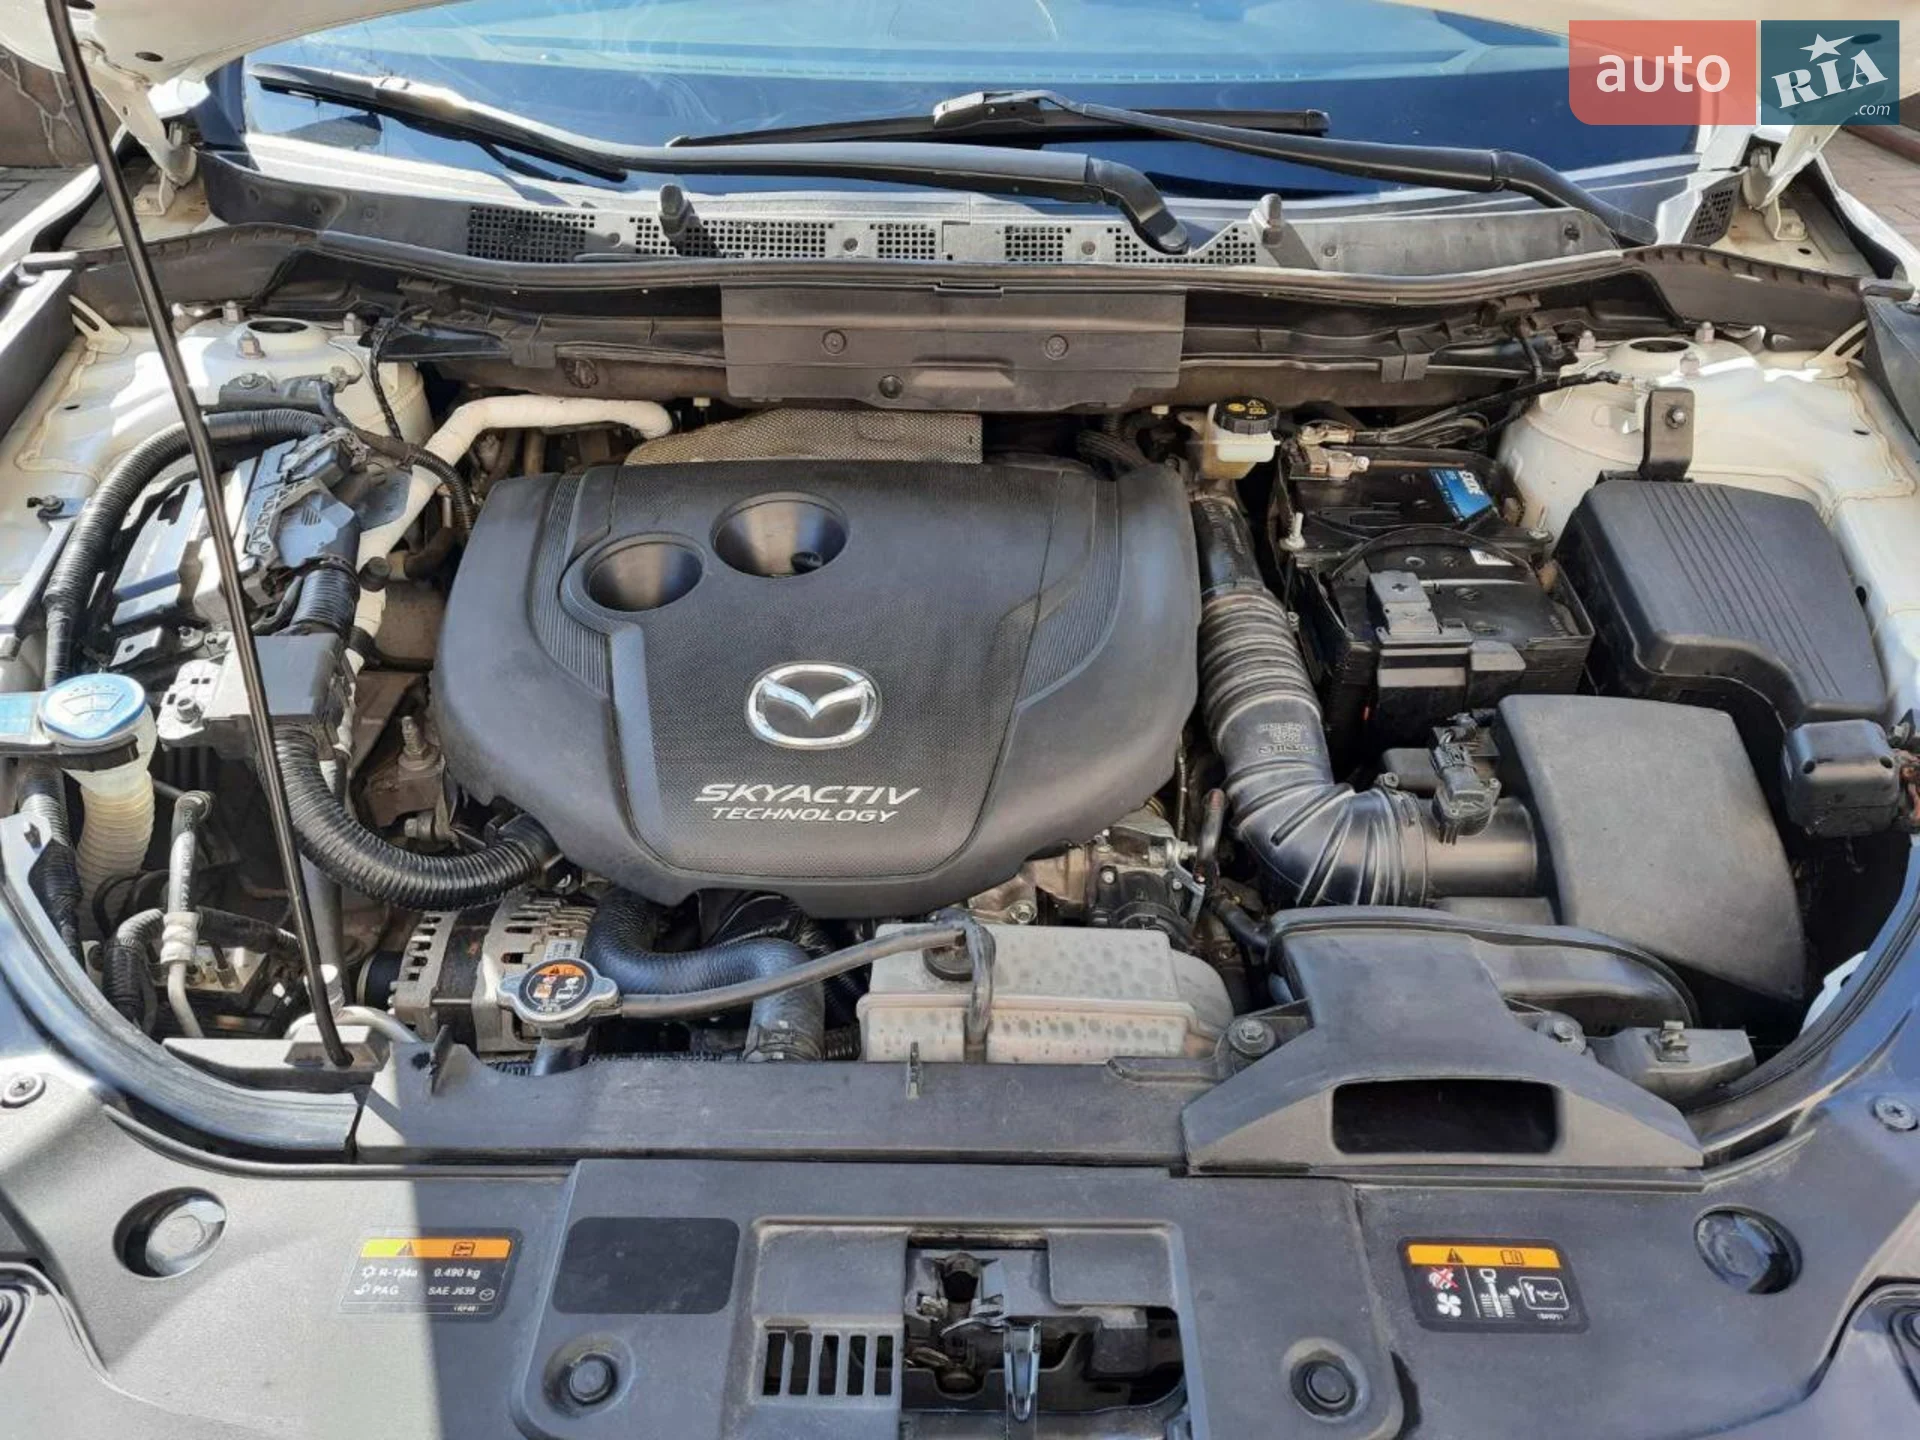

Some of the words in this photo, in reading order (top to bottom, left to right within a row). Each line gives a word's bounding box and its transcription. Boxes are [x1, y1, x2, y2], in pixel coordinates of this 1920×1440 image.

[694, 783, 921, 805] SKYACTIV
[711, 807, 899, 823] TECHNOLOGY
[466, 1267, 481, 1280] kg
[372, 1286, 400, 1296] PAG
[428, 1286, 451, 1295] SAE
